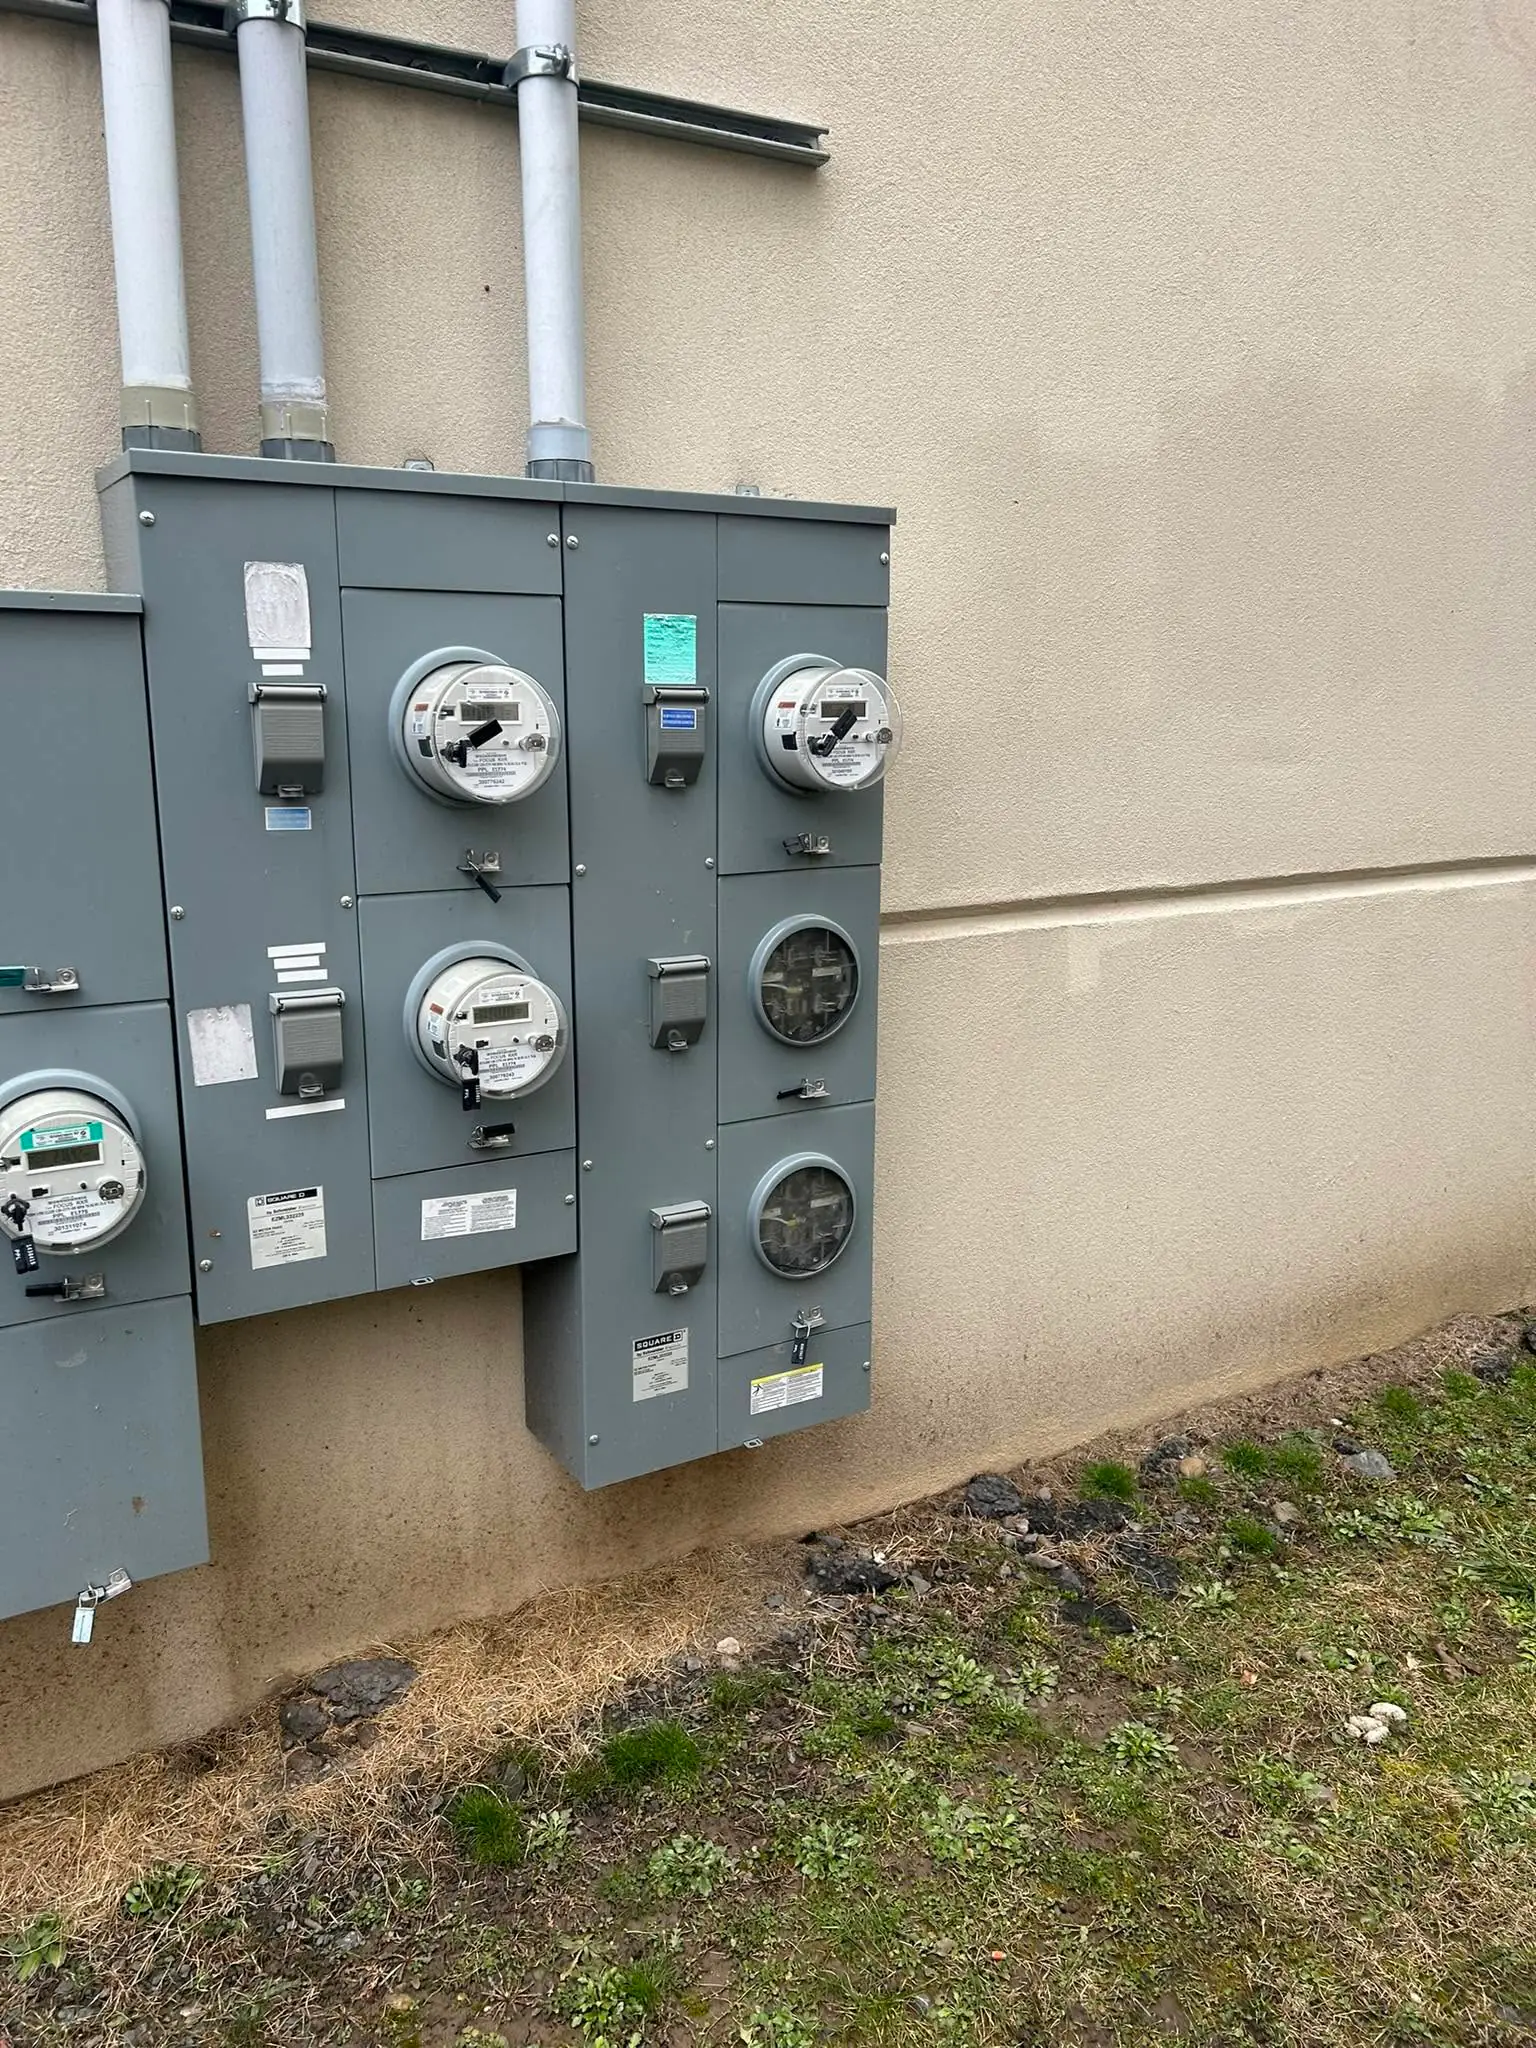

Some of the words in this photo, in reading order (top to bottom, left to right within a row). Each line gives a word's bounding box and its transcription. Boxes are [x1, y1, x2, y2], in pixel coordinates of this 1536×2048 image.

[267, 1193, 297, 1203] SQUARE
[53, 1201, 73, 1209] FOCUS
[636, 1335, 673, 1349] SQUARE
